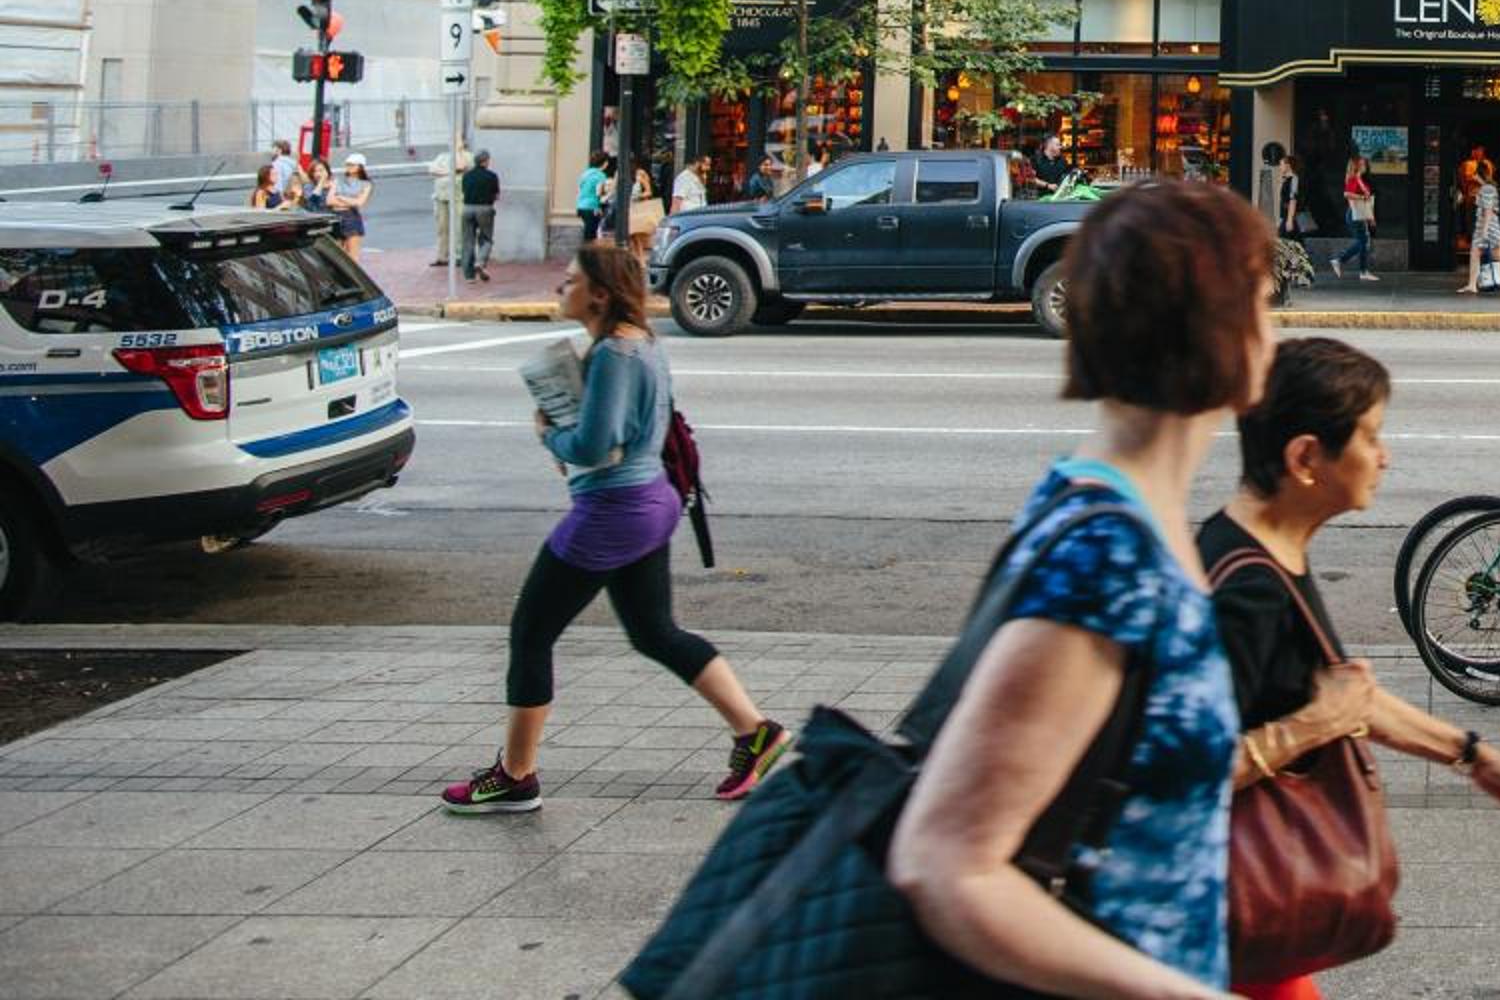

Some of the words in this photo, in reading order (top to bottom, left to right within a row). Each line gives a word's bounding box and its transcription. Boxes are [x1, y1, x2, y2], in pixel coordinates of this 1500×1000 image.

[449, 23, 463, 49] 9
[1395, 28, 1412, 39] The
[1413, 28, 1446, 41] Original
[1447, 29, 1485, 40] Boutique
[37, 289, 107, 309] D-4
[120, 333, 177, 347] 5532
[239, 325, 319, 353] BOSTON
